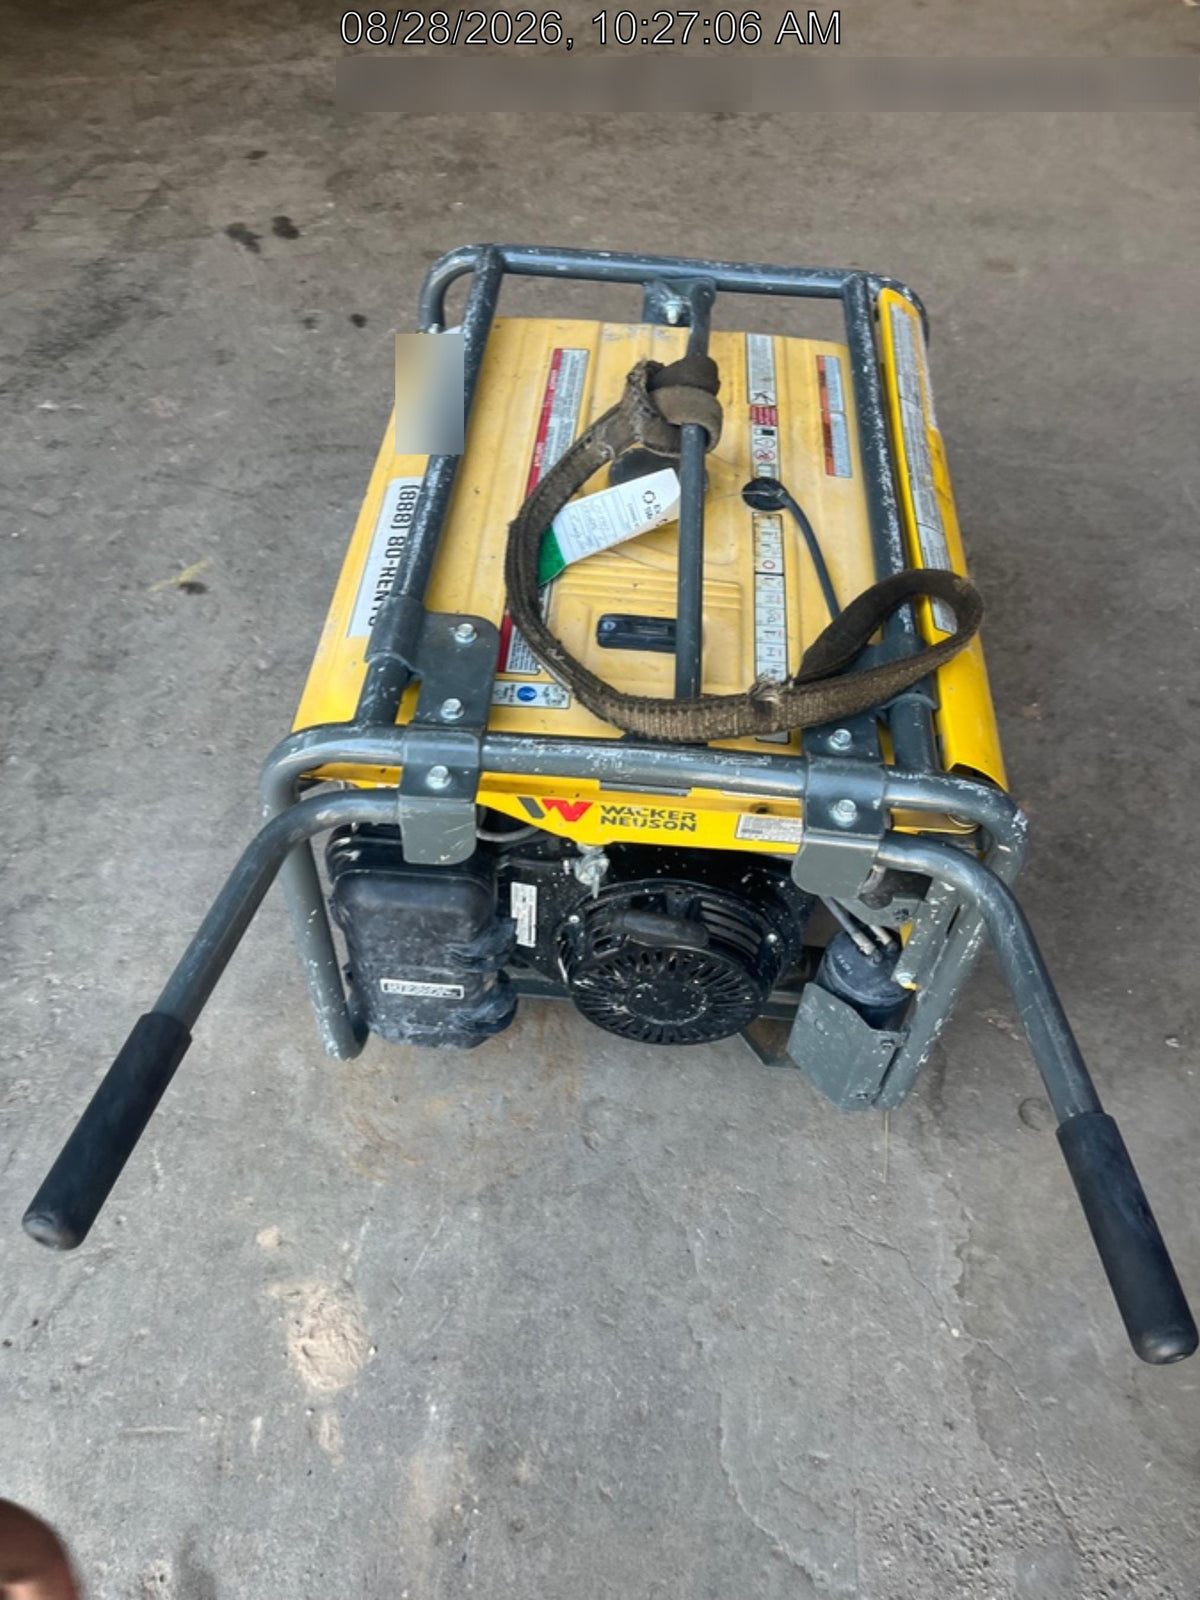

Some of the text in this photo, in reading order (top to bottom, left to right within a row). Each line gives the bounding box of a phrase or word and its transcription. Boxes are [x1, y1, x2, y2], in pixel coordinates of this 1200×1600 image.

[390, 484, 420, 529] (888)
[600, 805, 697, 821] WACKER
[600, 815, 697, 832] NEUSON
